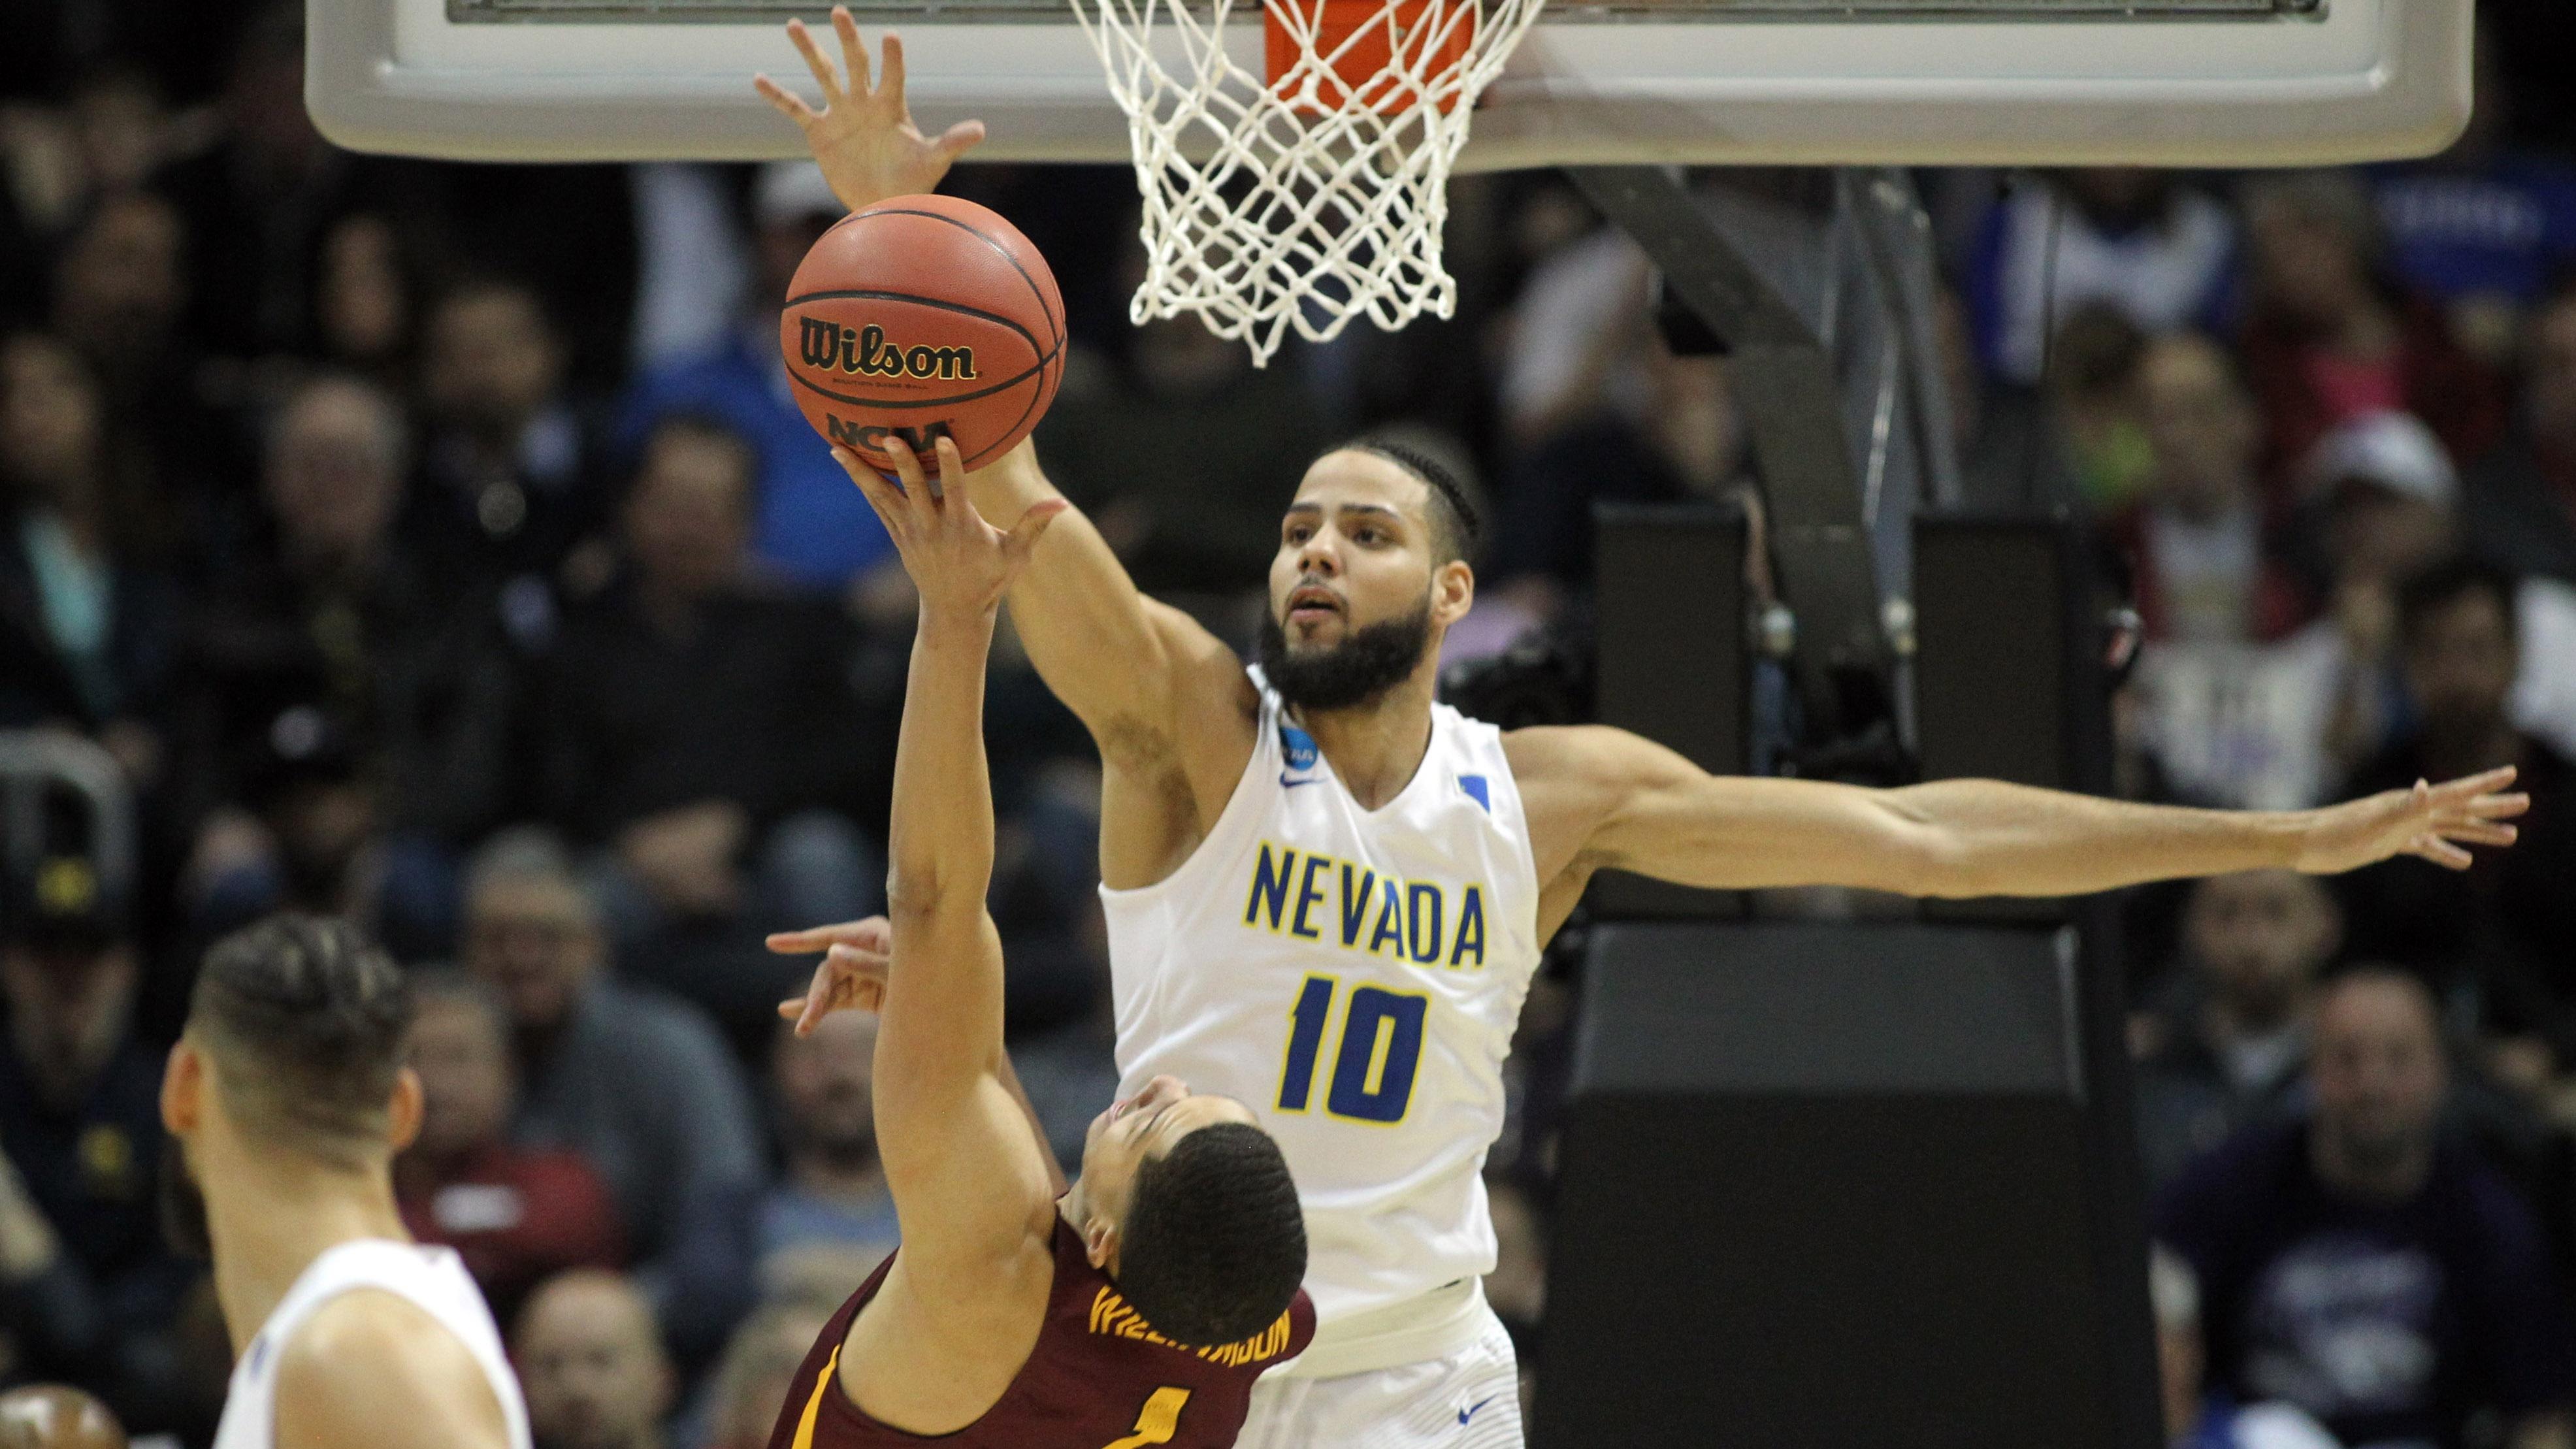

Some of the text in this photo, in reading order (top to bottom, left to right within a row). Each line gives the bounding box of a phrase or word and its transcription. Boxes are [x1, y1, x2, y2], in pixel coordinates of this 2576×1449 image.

[800, 316, 977, 380] Wilson
[1241, 840, 1488, 969] NEVADA
[1273, 971, 1431, 1128] 10
